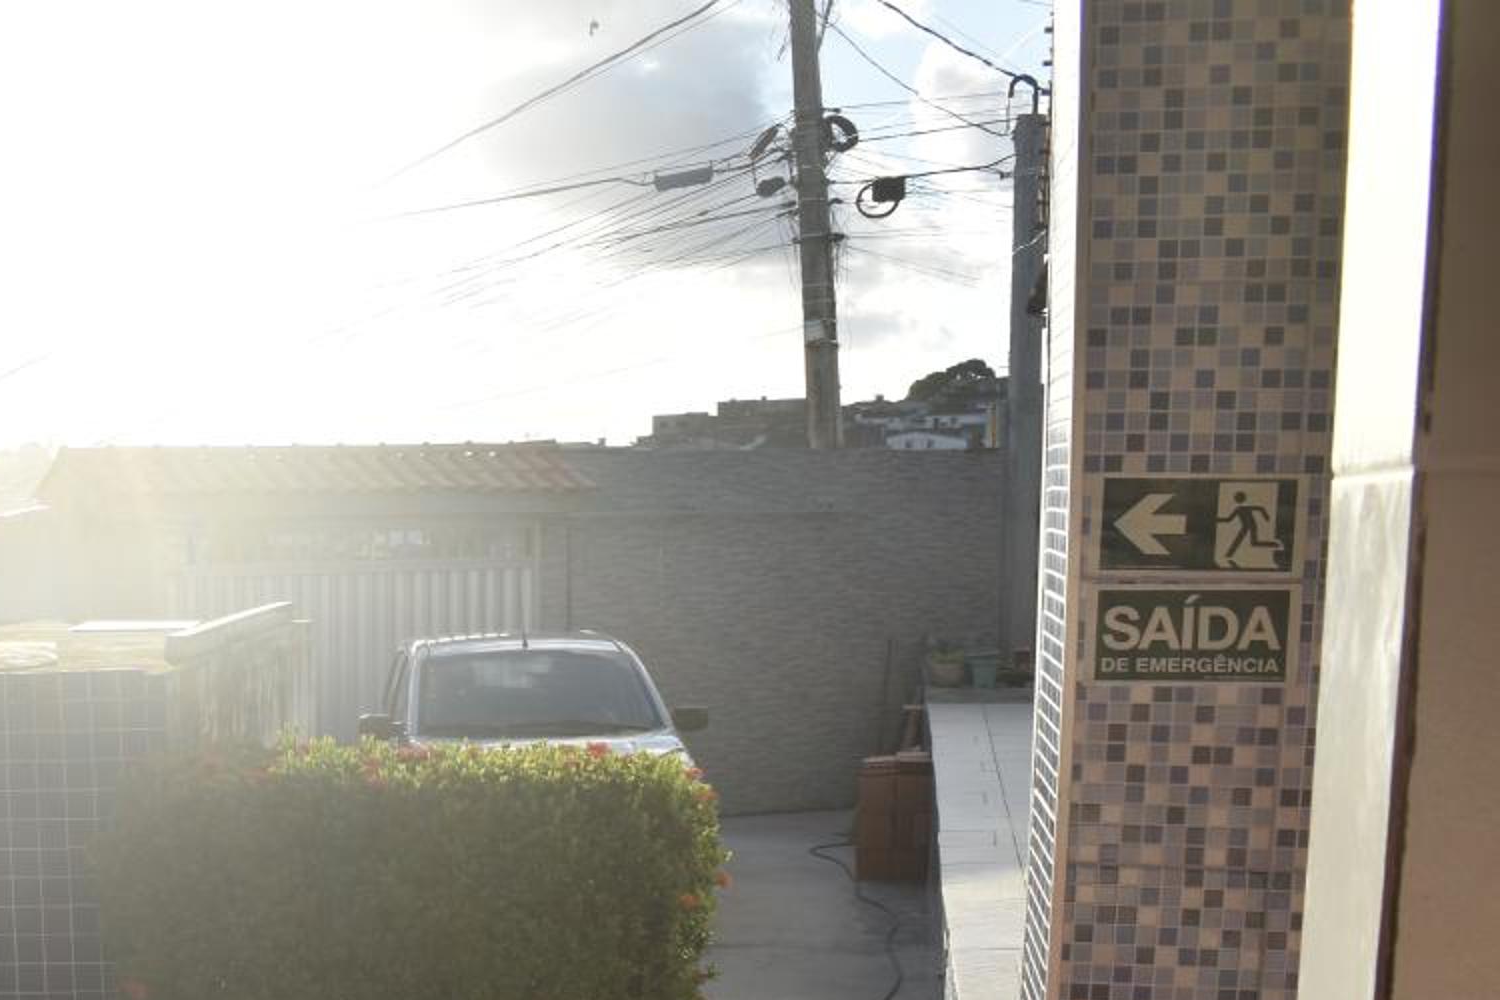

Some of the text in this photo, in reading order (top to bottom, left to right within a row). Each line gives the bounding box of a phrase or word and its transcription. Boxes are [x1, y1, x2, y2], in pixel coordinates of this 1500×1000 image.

[1102, 594, 1282, 651] SAÍDA
[1100, 653, 1279, 673] DE EMERGÊNCIA
